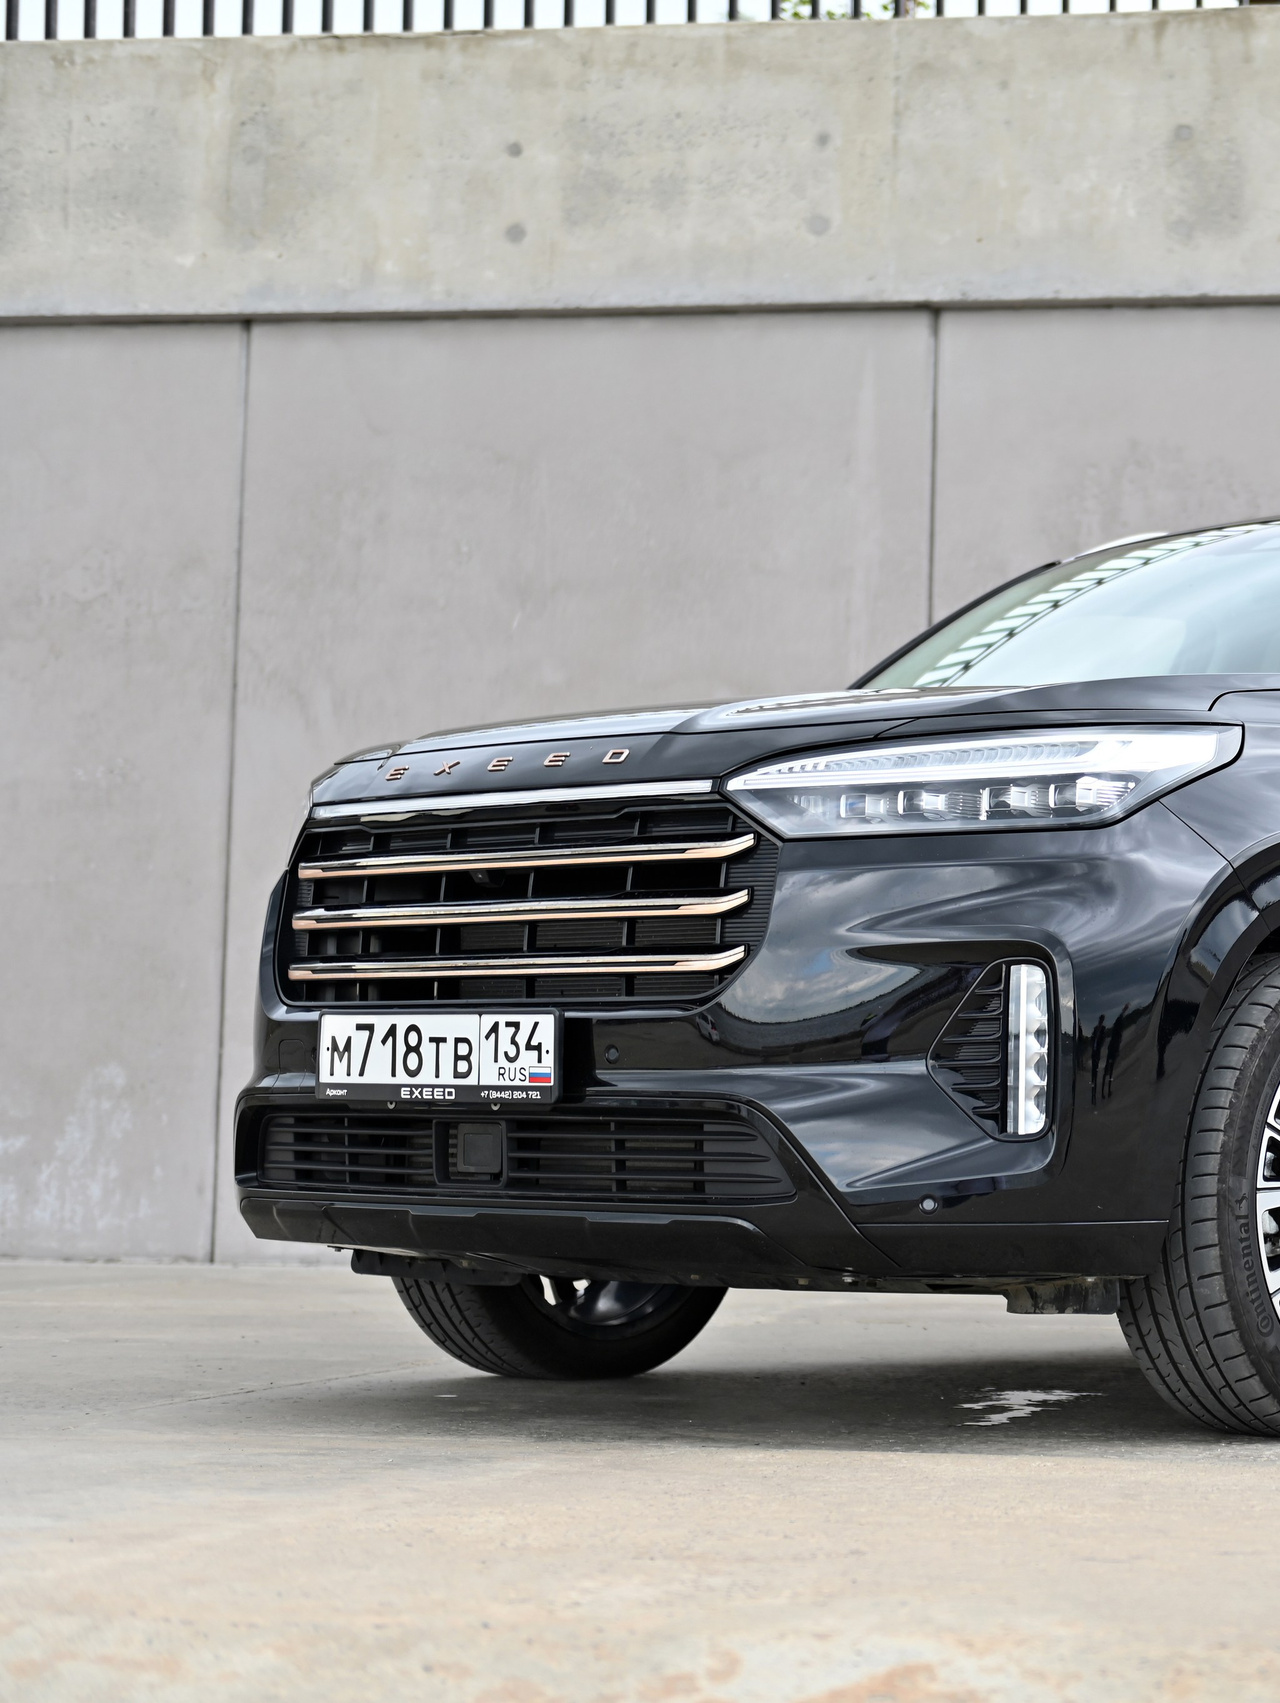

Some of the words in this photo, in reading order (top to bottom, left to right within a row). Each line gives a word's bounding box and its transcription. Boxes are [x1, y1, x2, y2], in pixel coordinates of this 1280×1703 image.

[385, 749, 629, 781] EXEED
[484, 1021, 543, 1063] 134
[498, 1066, 527, 1082] RUS
[400, 1087, 456, 1100] EXEED
[513, 1091, 527, 1099] 204
[528, 1091, 541, 1099] 721
[1235, 1214, 1275, 1338] Continental
